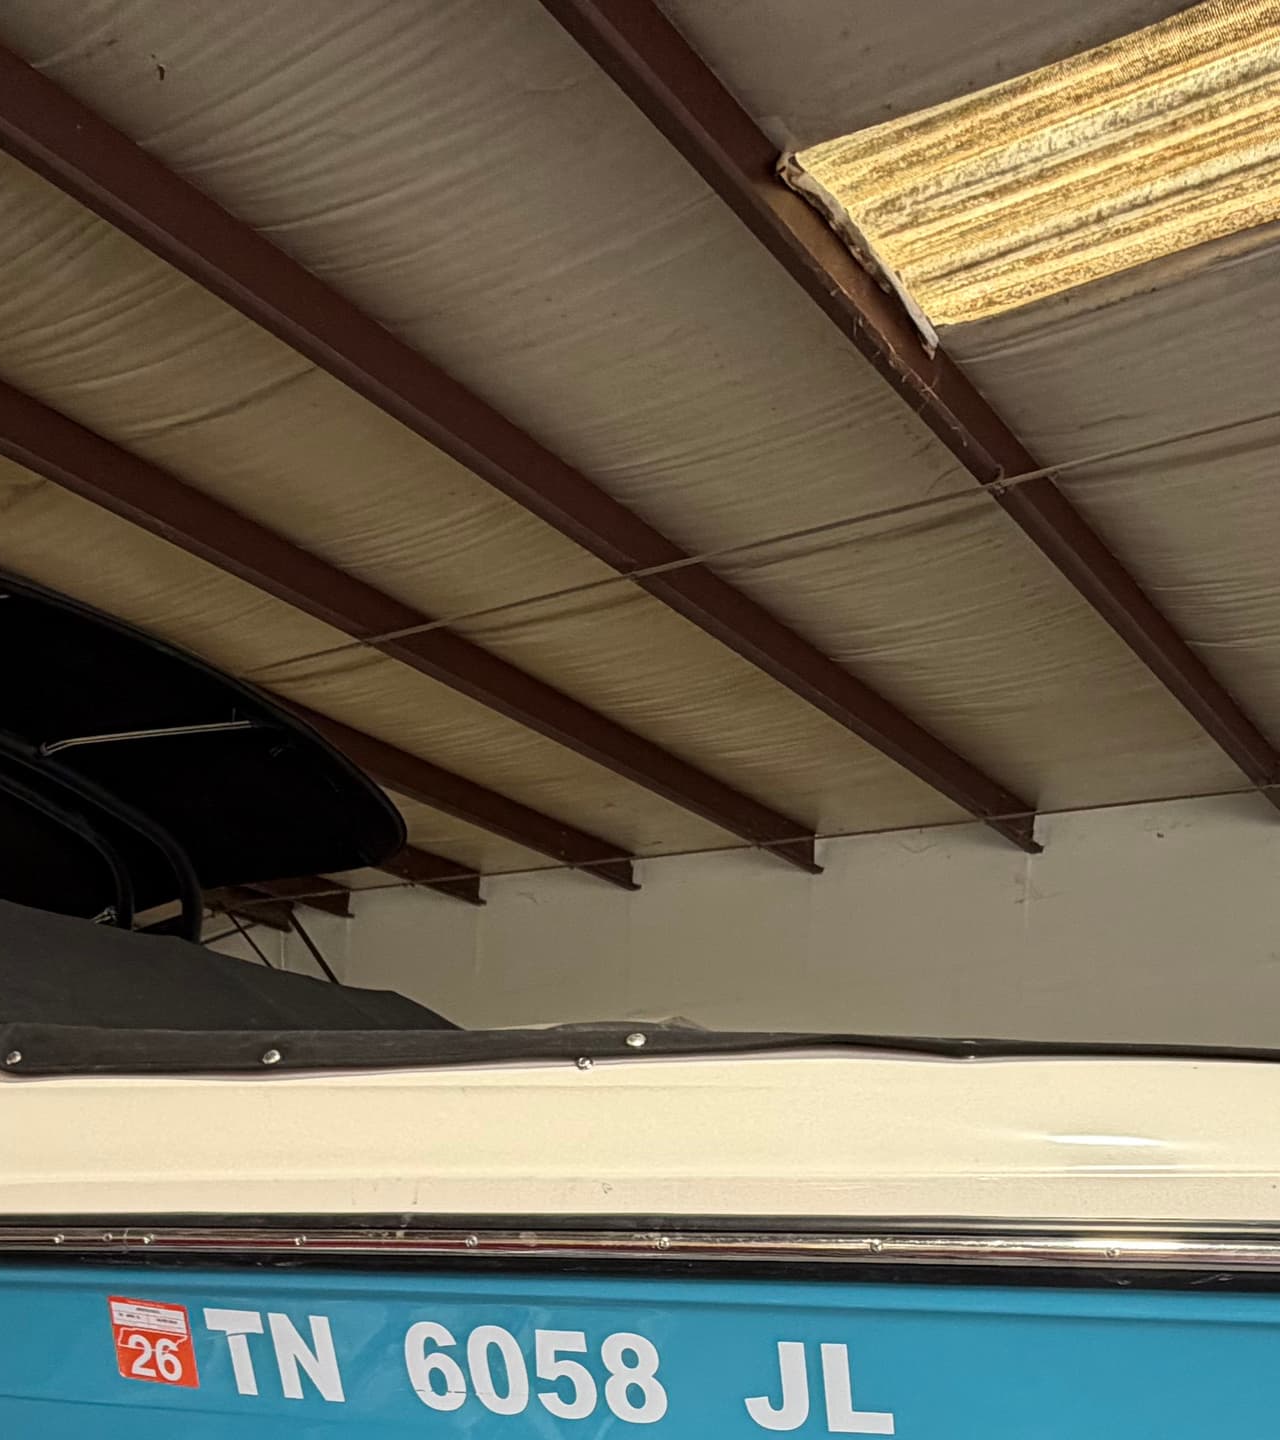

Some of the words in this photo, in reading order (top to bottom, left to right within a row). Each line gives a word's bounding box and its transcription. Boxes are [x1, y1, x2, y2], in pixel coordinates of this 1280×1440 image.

[128, 1334, 183, 1382] 26
[203, 1307, 346, 1403] TN
[404, 1320, 669, 1424] 6058
[743, 1340, 895, 1436] JL
